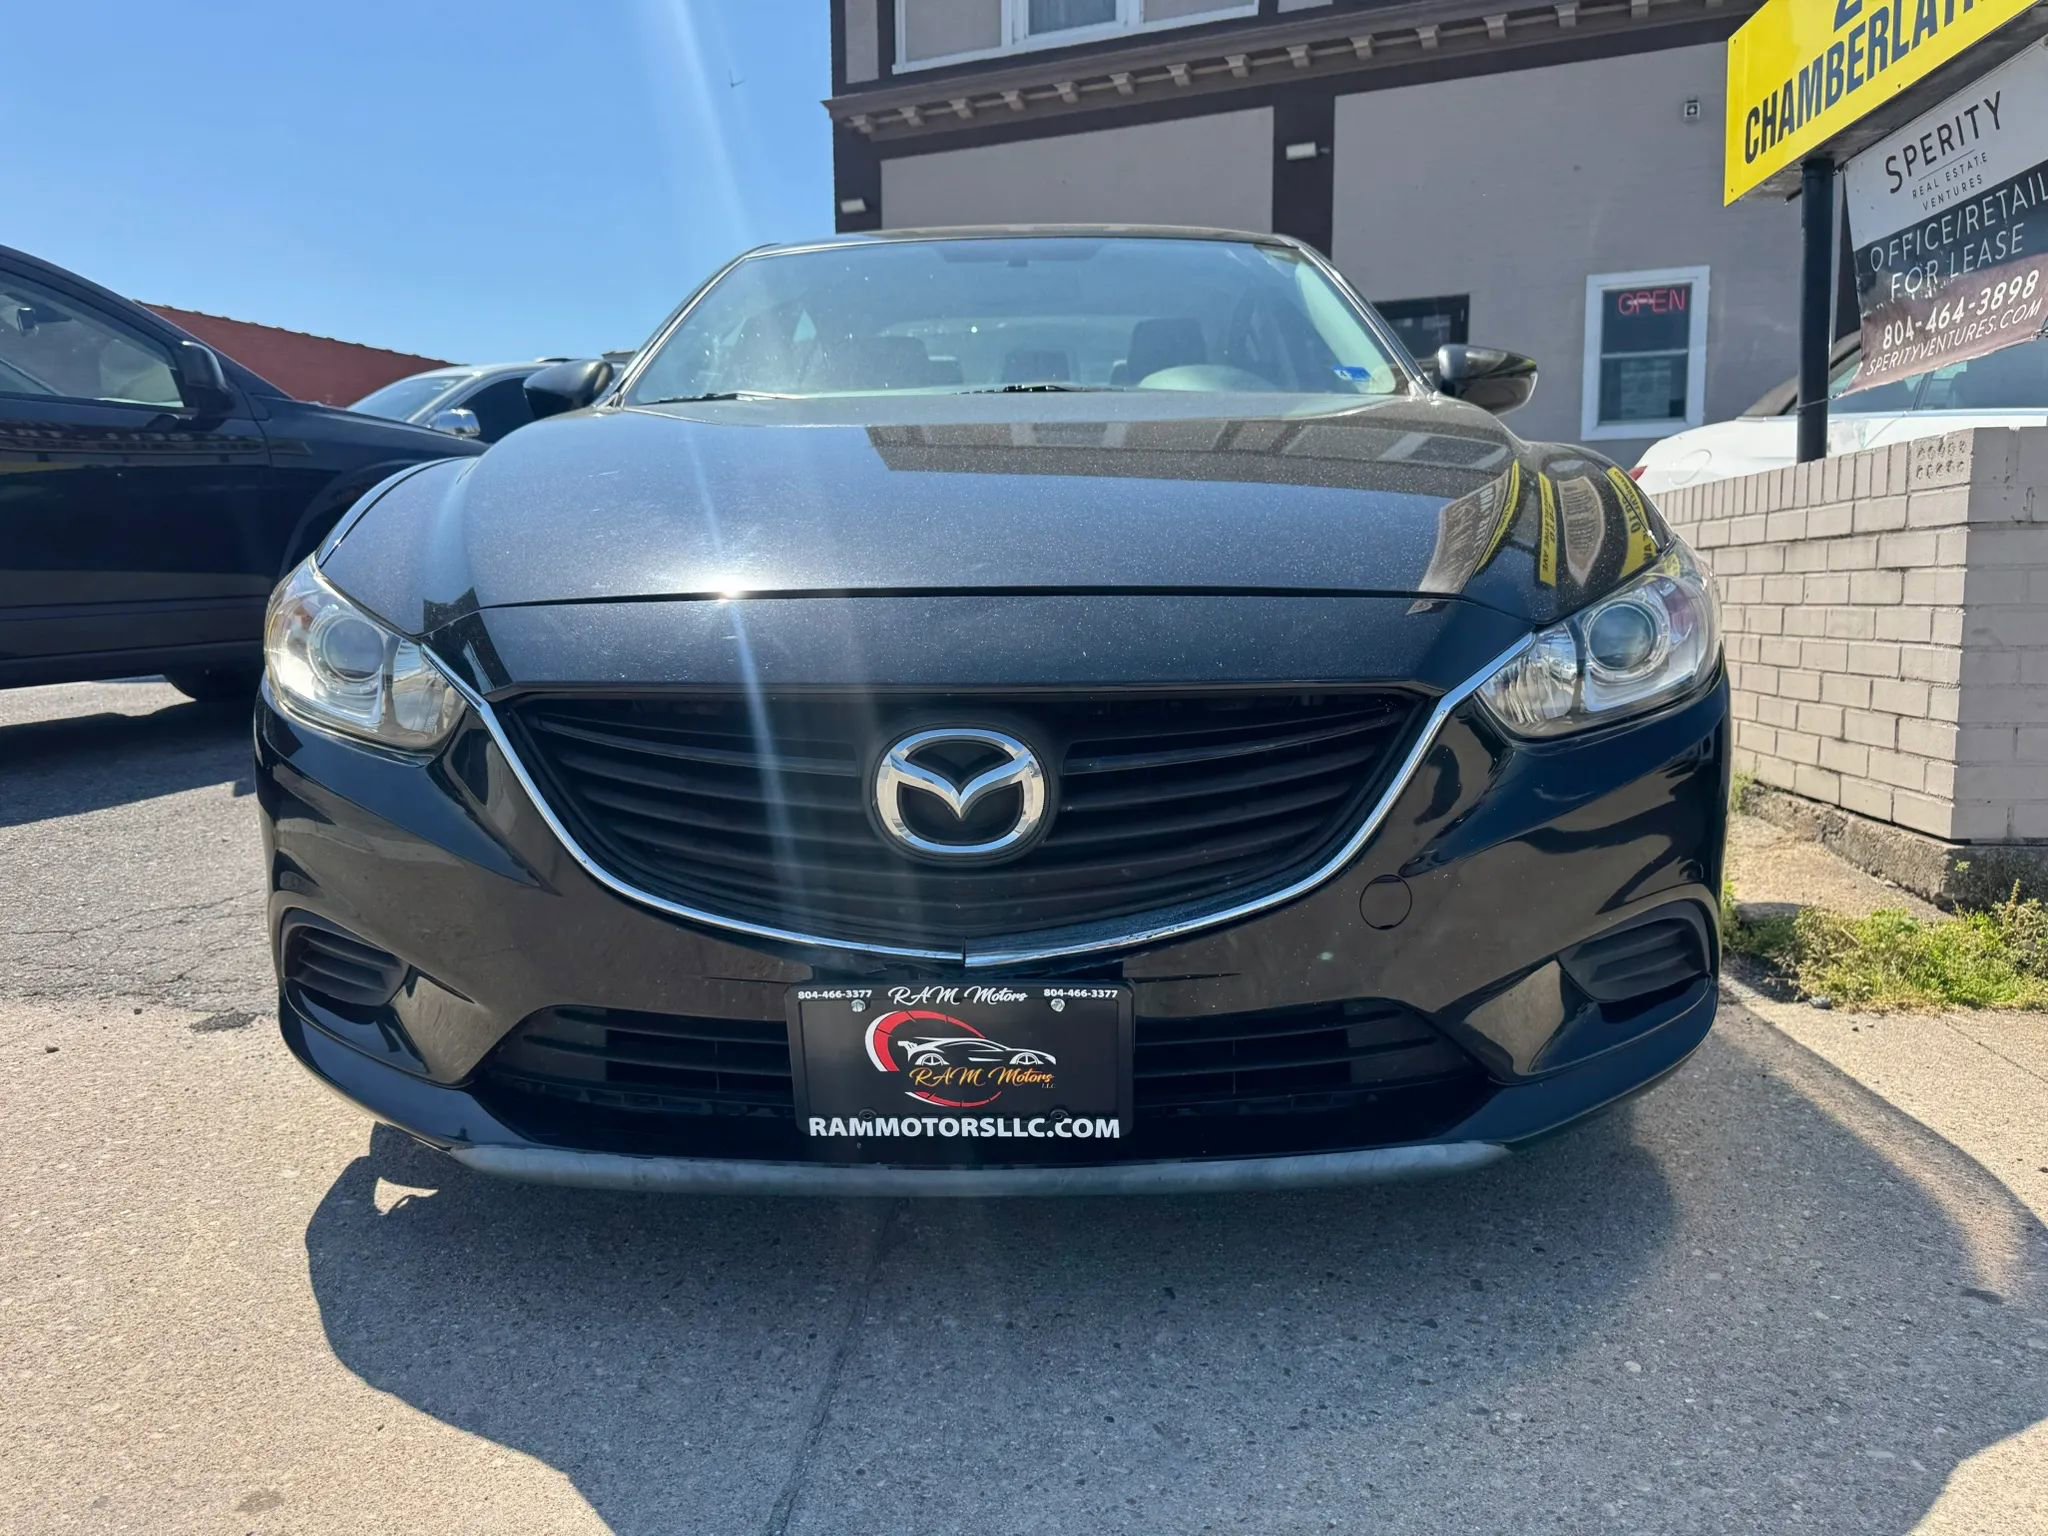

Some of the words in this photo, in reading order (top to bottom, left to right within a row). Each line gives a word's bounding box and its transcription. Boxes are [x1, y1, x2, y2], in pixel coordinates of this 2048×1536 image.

[1745, 0, 1983, 164] CHAMBERLA
[1885, 91, 2001, 194] SPERITY
[1912, 178, 1939, 199] REAL
[1946, 152, 1988, 182] ESTATE
[1923, 174, 1983, 211] VENTURES
[1870, 172, 2048, 272] OFFICE/RETAIL
[1891, 259, 1939, 301] FOR
[1949, 223, 2025, 278] LEASE
[1618, 288, 1686, 316] OPEN
[1882, 269, 2040, 350] 804-464-3898
[1866, 297, 2043, 376] SPERITYVENTURES.COM
[798, 990, 873, 1000] 804-466-3377
[888, 986, 960, 1006] RAM
[964, 985, 1028, 1005] Motors
[1043, 989, 1118, 999] 804-466-3377
[909, 1066, 986, 1087] RAM
[988, 1066, 1055, 1087] Motors
[808, 1117, 1121, 1139] RAMMOTORSLLC.COM
